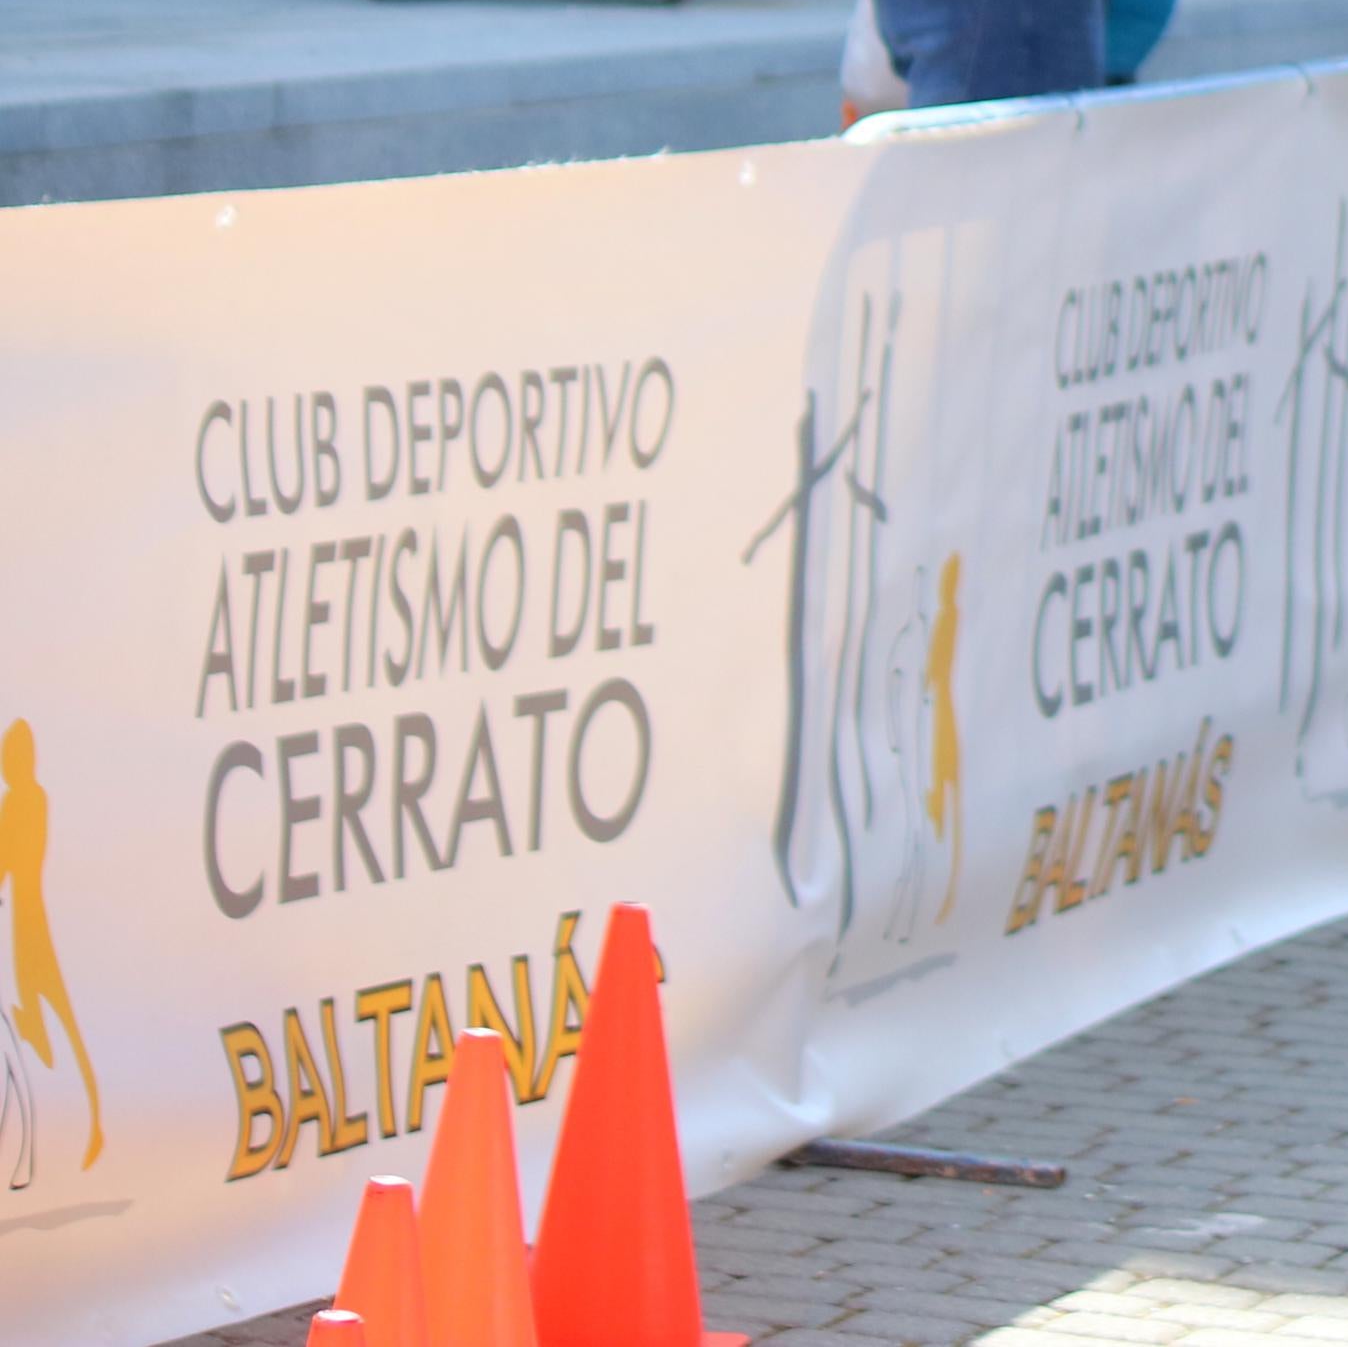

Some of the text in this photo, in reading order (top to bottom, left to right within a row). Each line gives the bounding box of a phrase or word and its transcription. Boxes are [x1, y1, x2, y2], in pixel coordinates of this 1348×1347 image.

[1054, 250, 1268, 390] CLUB DEPORTIVO
[195, 355, 675, 524] CLUB DEPORTIVO
[1040, 369, 1251, 554] ATLETISMO DEL
[195, 498, 656, 718] ATLETISMO DEL
[1031, 518, 1244, 719] CERRATO
[202, 675, 652, 920] CERRATO
[1004, 713, 1234, 936] BALTANÁS
[219, 910, 667, 1183] BALTANÁ
